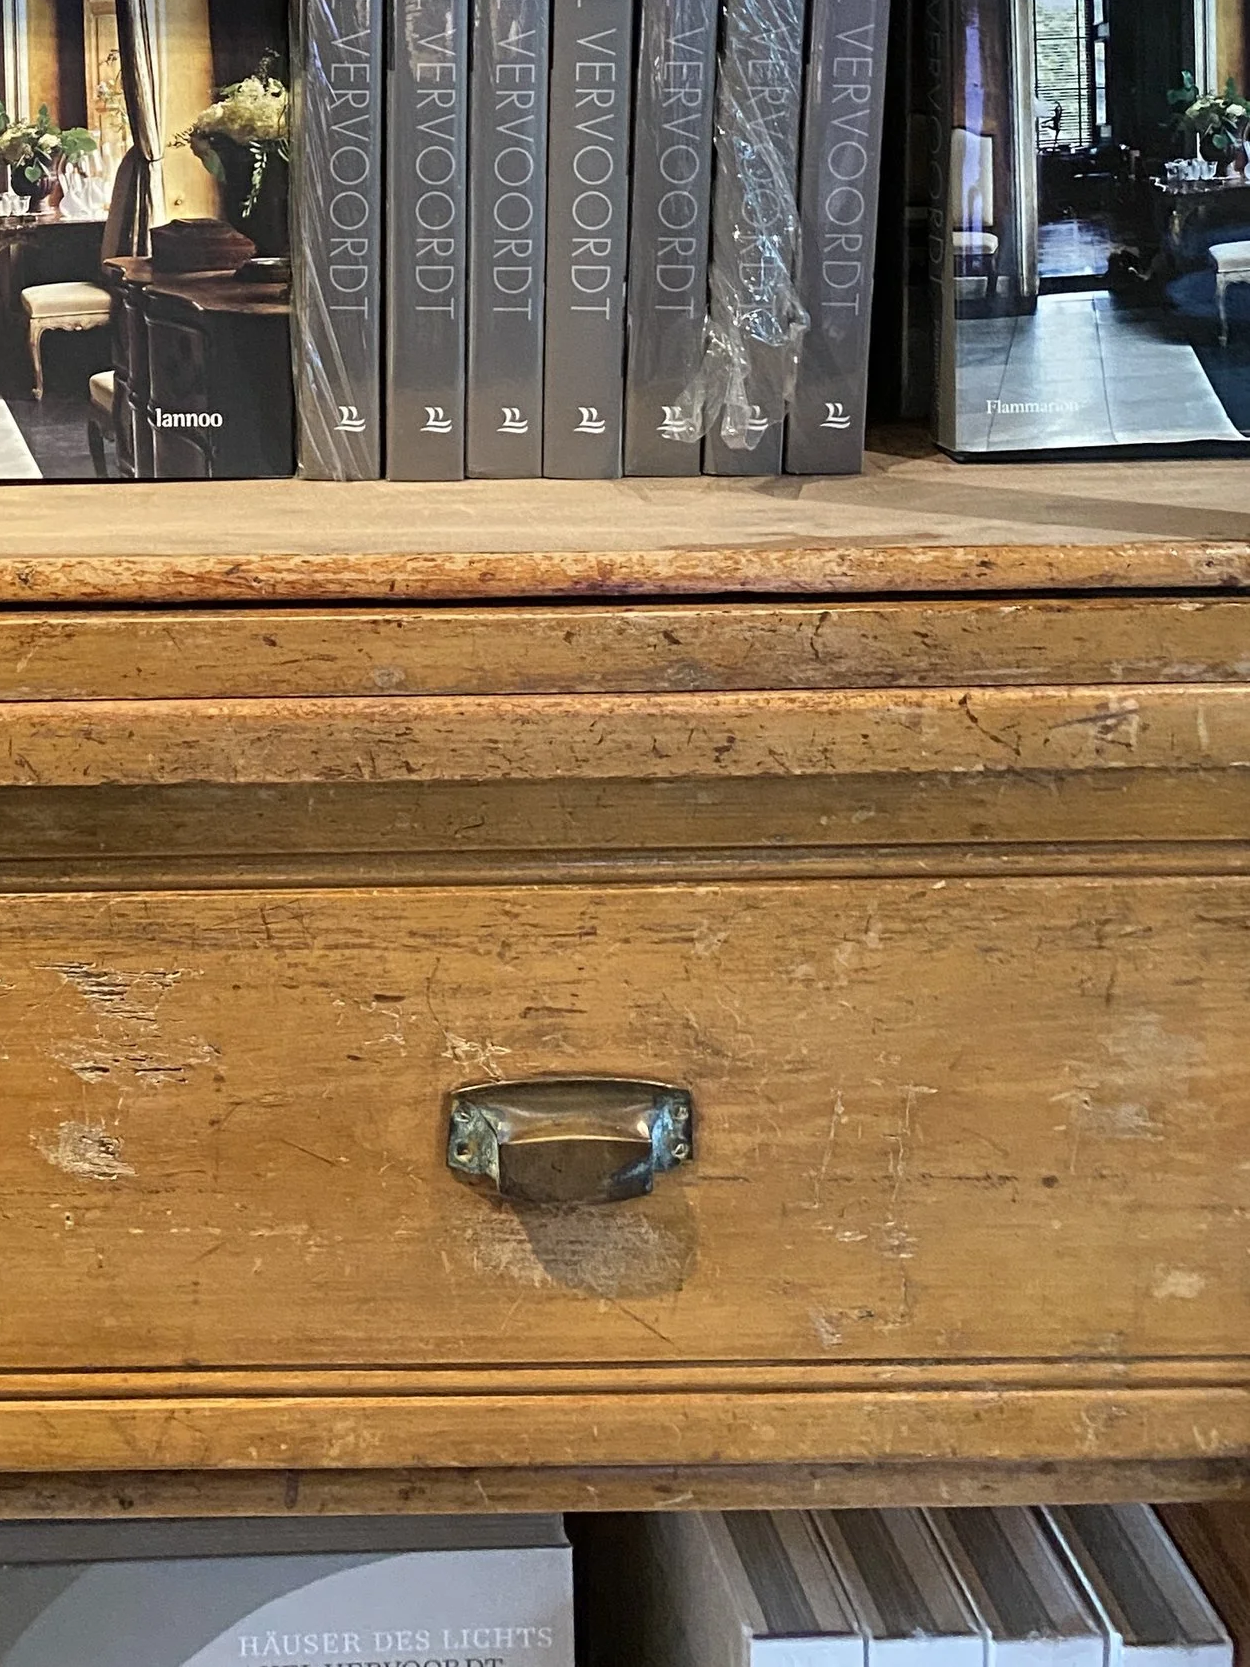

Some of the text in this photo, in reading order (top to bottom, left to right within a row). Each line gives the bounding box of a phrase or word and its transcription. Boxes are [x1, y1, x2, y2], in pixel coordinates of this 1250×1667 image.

[329, 30, 371, 319] VERVOORDT
[414, 30, 457, 320] VERVOORDT
[492, 31, 536, 321] VERVOORDT
[570, 29, 617, 320] VERVOORDT
[654, 32, 705, 318] VERVOORDT
[820, 29, 874, 317] VERVOORDT
[155, 407, 223, 428] lannoo
[986, 399, 1079, 415] Flammarion
[239, 1627, 554, 1657] HÄUSER DES LICHTS
